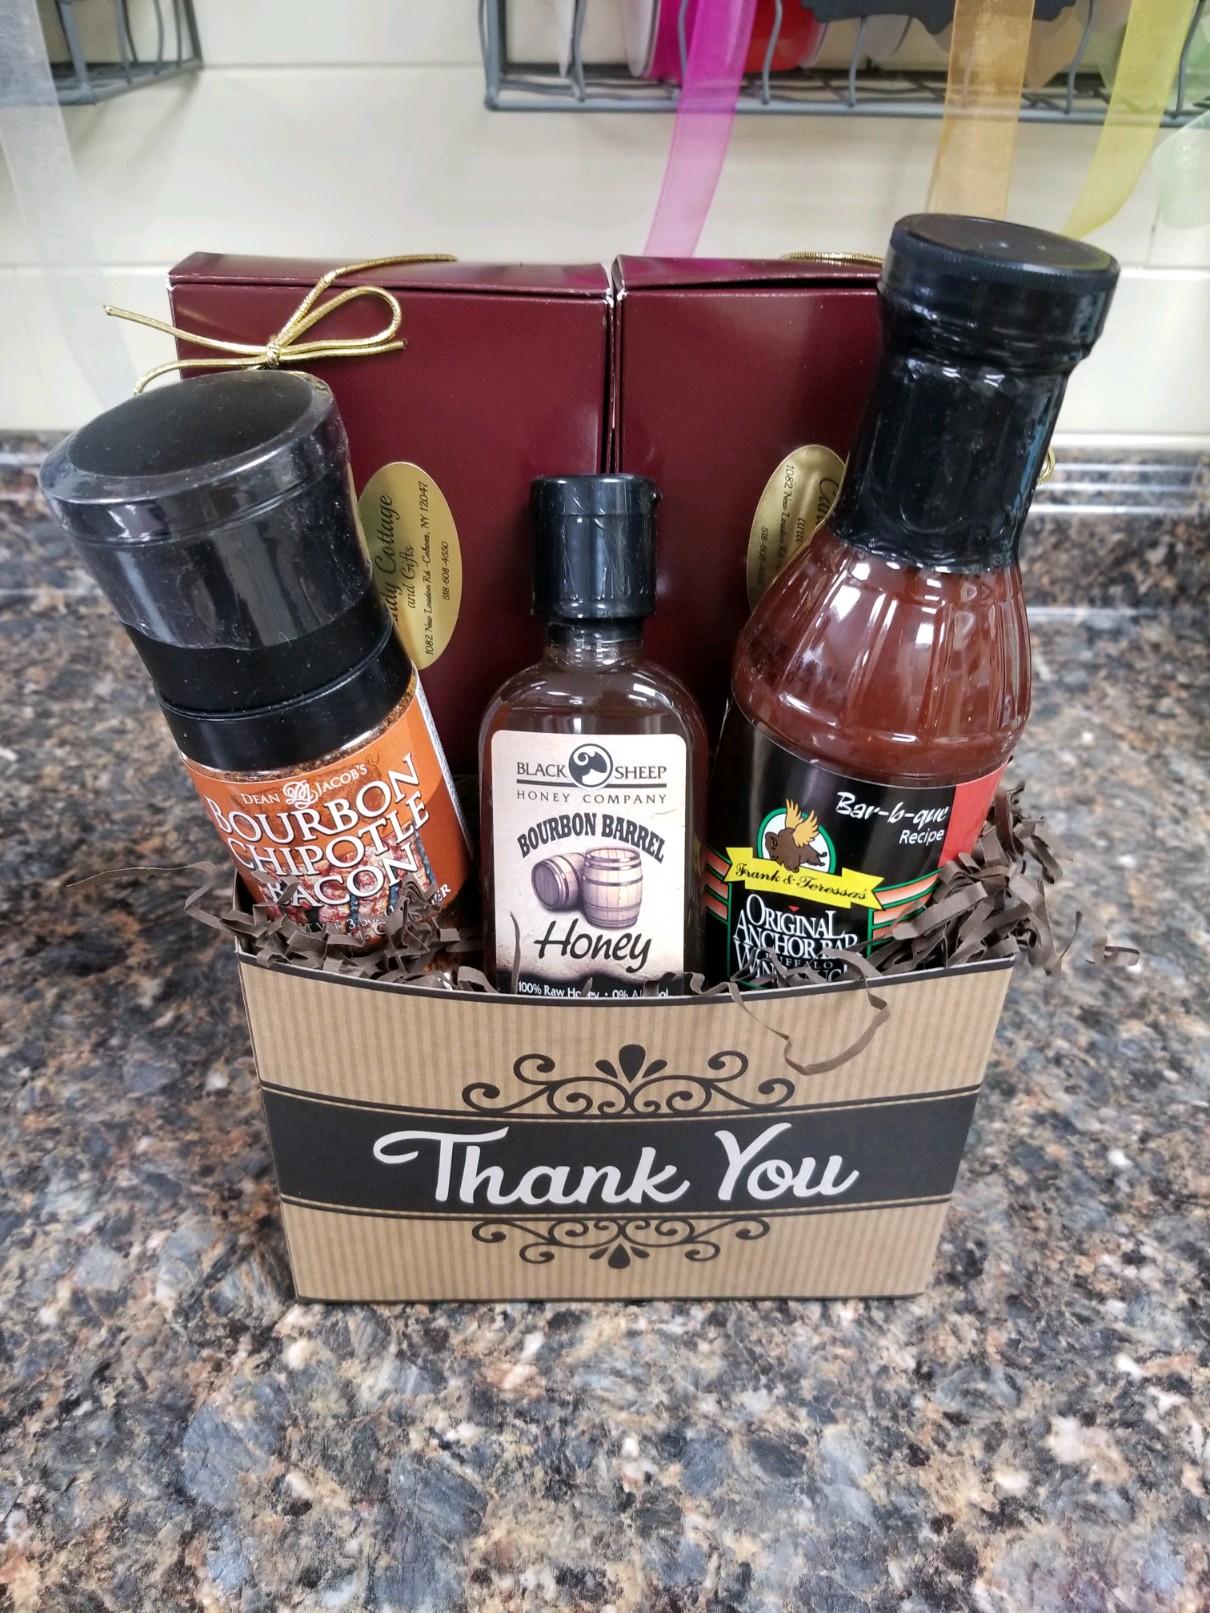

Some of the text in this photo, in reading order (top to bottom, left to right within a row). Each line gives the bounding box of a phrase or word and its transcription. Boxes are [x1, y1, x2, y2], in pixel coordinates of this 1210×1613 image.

[419, 481, 429, 512] 12047
[783, 464, 795, 490] 1082
[420, 513, 430, 529] NY
[816, 478, 839, 525] Can
[375, 495, 403, 625] ndy Cottage
[401, 546, 419, 609] and Gifts
[423, 569, 433, 582] Rd
[424, 612, 433, 631] New
[424, 633, 435, 656] 1082
[240, 792, 281, 805] DEAN
[316, 763, 368, 796] JACOB'S
[516, 761, 667, 780] BLACK SHEEP
[204, 752, 421, 844] BOURBON
[517, 790, 667, 804] HONEY COMPANY
[835, 791, 949, 830] Bar-b-que
[227, 791, 430, 876] CHIPOTLE
[517, 812, 666, 864] BOURBON BARREL
[899, 829, 945, 846] Recipe
[736, 862, 780, 882] Frank
[783, 873, 796, 885] &
[733, 909, 819, 959] ANCHOR
[746, 893, 846, 939] ORIGINAL
[534, 917, 652, 974] Honey
[518, 980, 542, 995] 100%
[544, 984, 566, 997] Raw
[567, 987, 600, 998] Hoey
[373, 1122, 860, 1205] Thank You
